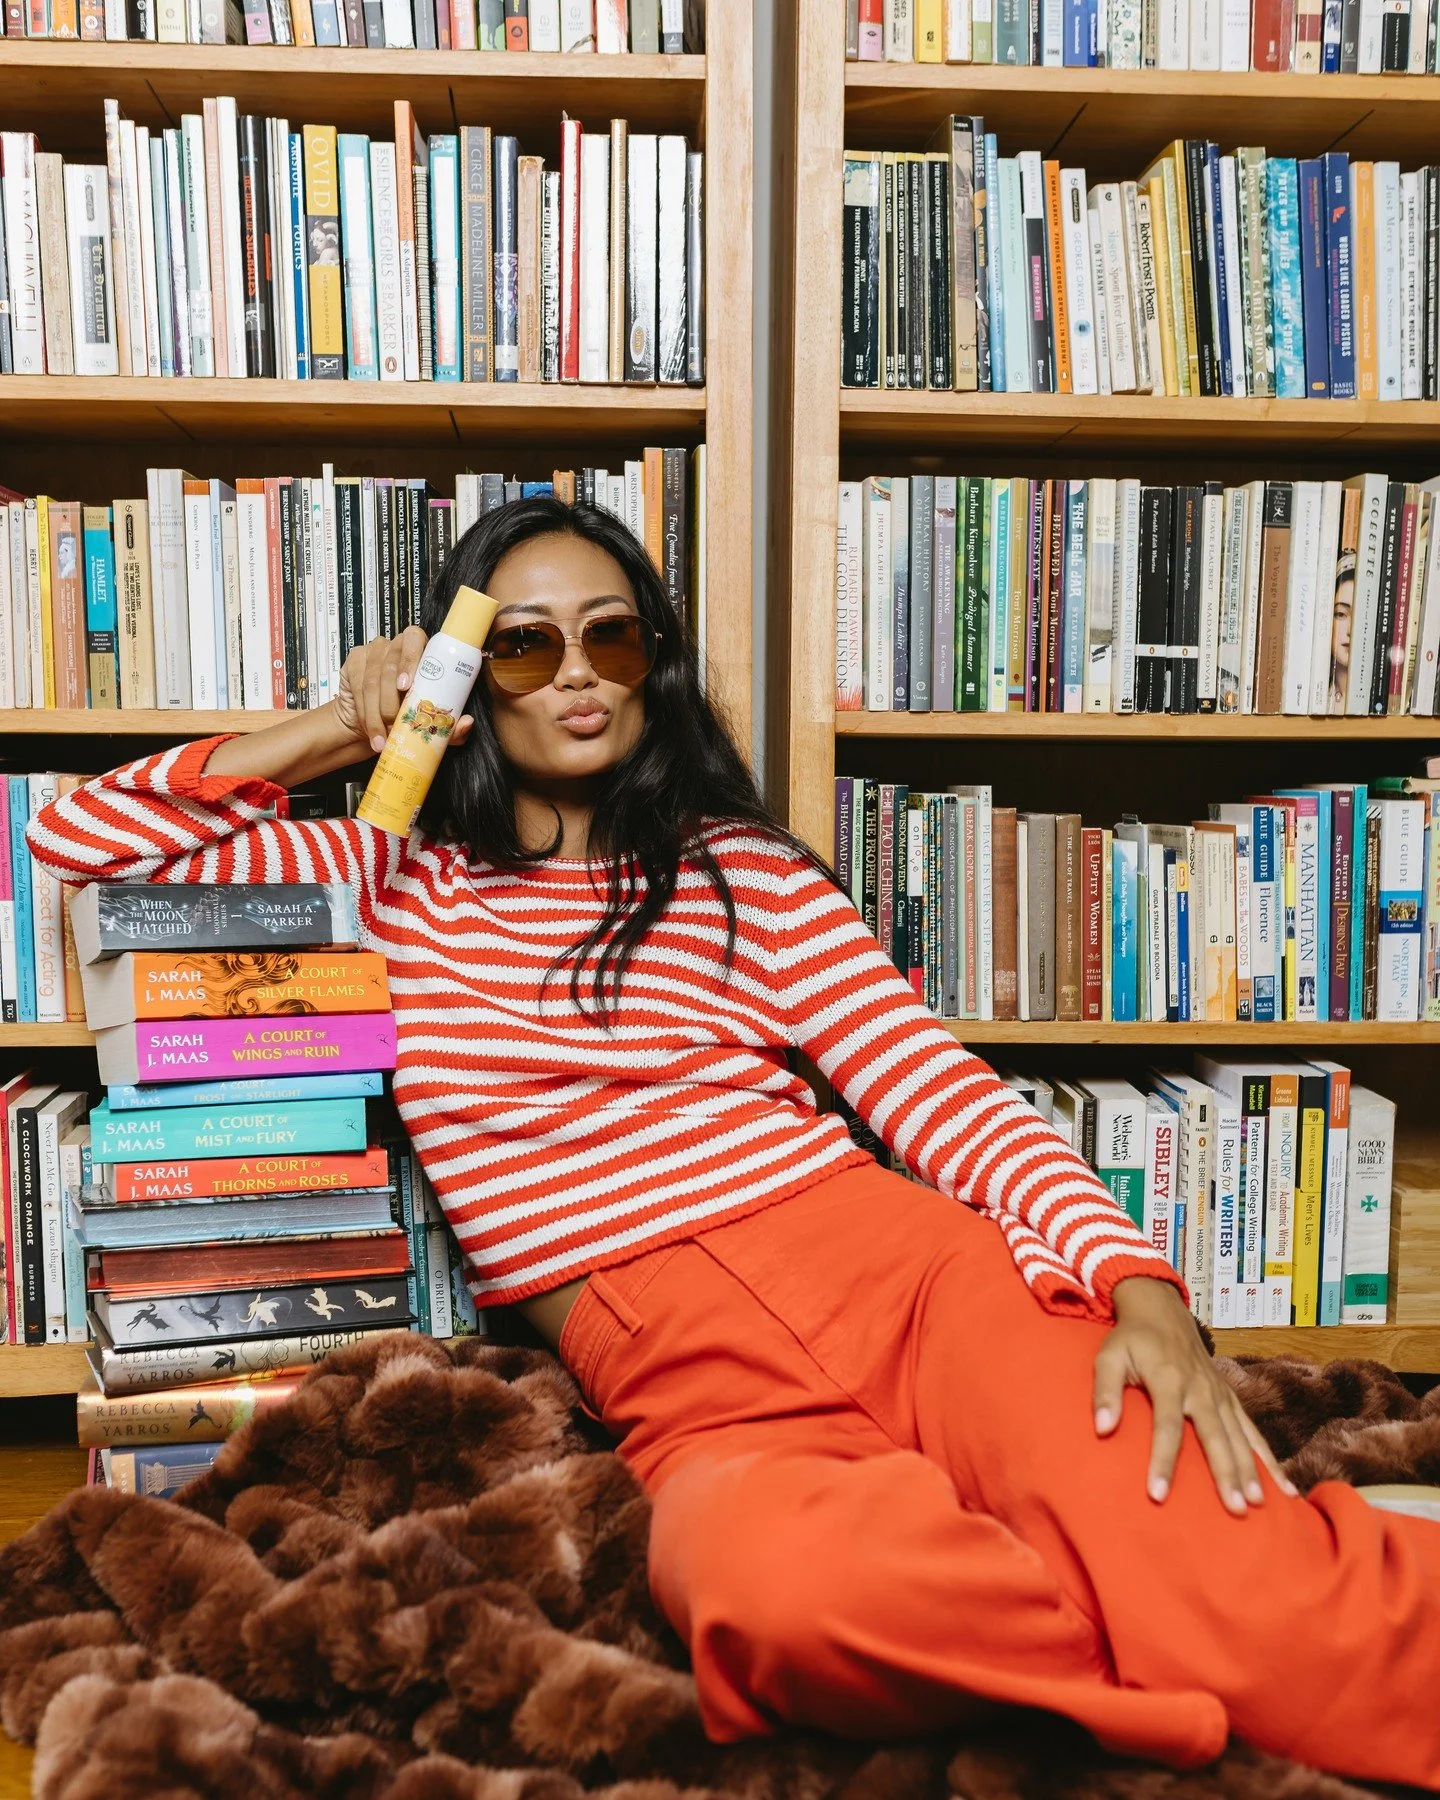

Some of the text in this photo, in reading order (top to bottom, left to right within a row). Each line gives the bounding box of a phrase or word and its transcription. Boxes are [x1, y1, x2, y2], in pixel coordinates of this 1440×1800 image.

[310, 137, 331, 208] OVID
[470, 149, 482, 190] CIRCE
[975, 135, 985, 178] STONES
[1050, 175, 1058, 196] EMMA
[471, 205, 484, 331] MADELINE MILLER
[1054, 232, 1062, 263] FINDING
[1055, 265, 1063, 294] GEORGE
[1073, 231, 1086, 311] GEORGE ORWELL
[1094, 243, 1104, 297] ON TYRANNY
[1140, 223, 1155, 320] Robert Frost's Poems
[322, 274, 330, 346] METAMORPHOSES
[1057, 296, 1065, 326] ORWELL
[1339, 236, 1351, 357] WORDS LIKE LOADED PISTOLS
[1059, 328, 1065, 337] IN
[1253, 280, 1264, 364] CARLY SIMON
[967, 486, 979, 578] Barbara Kingsolver
[1051, 514, 1061, 576] BELOVED
[1069, 502, 1084, 597] THE BELL JAR
[1365, 497, 1381, 579] COLETTE
[667, 514, 678, 597] Five Comedies from the
[1386, 535, 1395, 576] WOMAN
[96, 558, 107, 602] HAMLET
[836, 524, 847, 689] THE GOD DELUSION
[848, 546, 858, 668] RICHARD DAWKINS
[897, 586, 905, 650] Jhumpa Lahiri
[1049, 589, 1059, 663] Toni Morrison
[1382, 580, 1391, 633] WARRIOR
[966, 586, 978, 672] Prodigal Summer
[421, 664, 437, 677] MAGIC
[423, 659, 443, 673] CITRUS
[455, 666, 472, 678] EDITION
[457, 660, 474, 672] LIMITED
[866, 808, 877, 896] THE PROPHET
[966, 807, 974, 882] DEEPAK CHOPRA
[1260, 810, 1268, 878] BLUE GUIDE
[882, 823, 893, 910] TAO TE CHING
[140, 900, 172, 910] WHEN
[144, 909, 189, 922] MOON
[258, 904, 317, 914] SARAH A.
[263, 916, 313, 927] PARKER
[1090, 901, 1099, 945] WOMEN
[1260, 887, 1271, 943] Florence
[1301, 843, 1315, 961] MANHATTAN
[129, 921, 191, 935] HATCHED
[148, 971, 201, 983] SARAH
[256, 985, 365, 998] SILVER FLAMES
[284, 968, 295, 979] A
[299, 967, 346, 979] COURT
[145, 988, 206, 1003] J. MAAS
[150, 1034, 203, 1047] SARAH
[232, 1047, 282, 1061] WINGS
[304, 1045, 340, 1057] RUIN
[244, 1030, 326, 1043] A COURT OF
[147, 1051, 209, 1067] J. MAAS
[105, 1121, 161, 1134] SARAH
[195, 1133, 232, 1146] MIST
[256, 1131, 297, 1145] FURY
[202, 1116, 288, 1129] A COURT OF
[1112, 1114, 1121, 1161] New World
[1122, 1114, 1132, 1161] Webster's
[23, 1130, 32, 1195] CLOCKWORK
[45, 1122, 56, 1196] Never Let Me Go
[102, 1137, 165, 1154] J. MAAS
[239, 1161, 250, 1173] A
[254, 1160, 307, 1172] COURT
[1155, 1127, 1171, 1197] SIBLEY
[130, 1183, 193, 1200] J. MAAS
[133, 1166, 189, 1179] SARAH
[212, 1177, 276, 1191] THORNS
[299, 1174, 348, 1186] ROSES
[1247, 1122, 1260, 1252] Patterns for College Writing
[1220, 1139, 1235, 1257] Rules for WRITERS
[26, 1202, 34, 1245] ORANGE
[1304, 1195, 1315, 1246] Men's Lives
[48, 1219, 58, 1283] Kazuo Ishiguro
[120, 1347, 200, 1364] REBECCA
[127, 1369, 195, 1385] YARROS
[96, 1403, 176, 1417] REBECCA
[103, 1423, 171, 1437] YARROS
